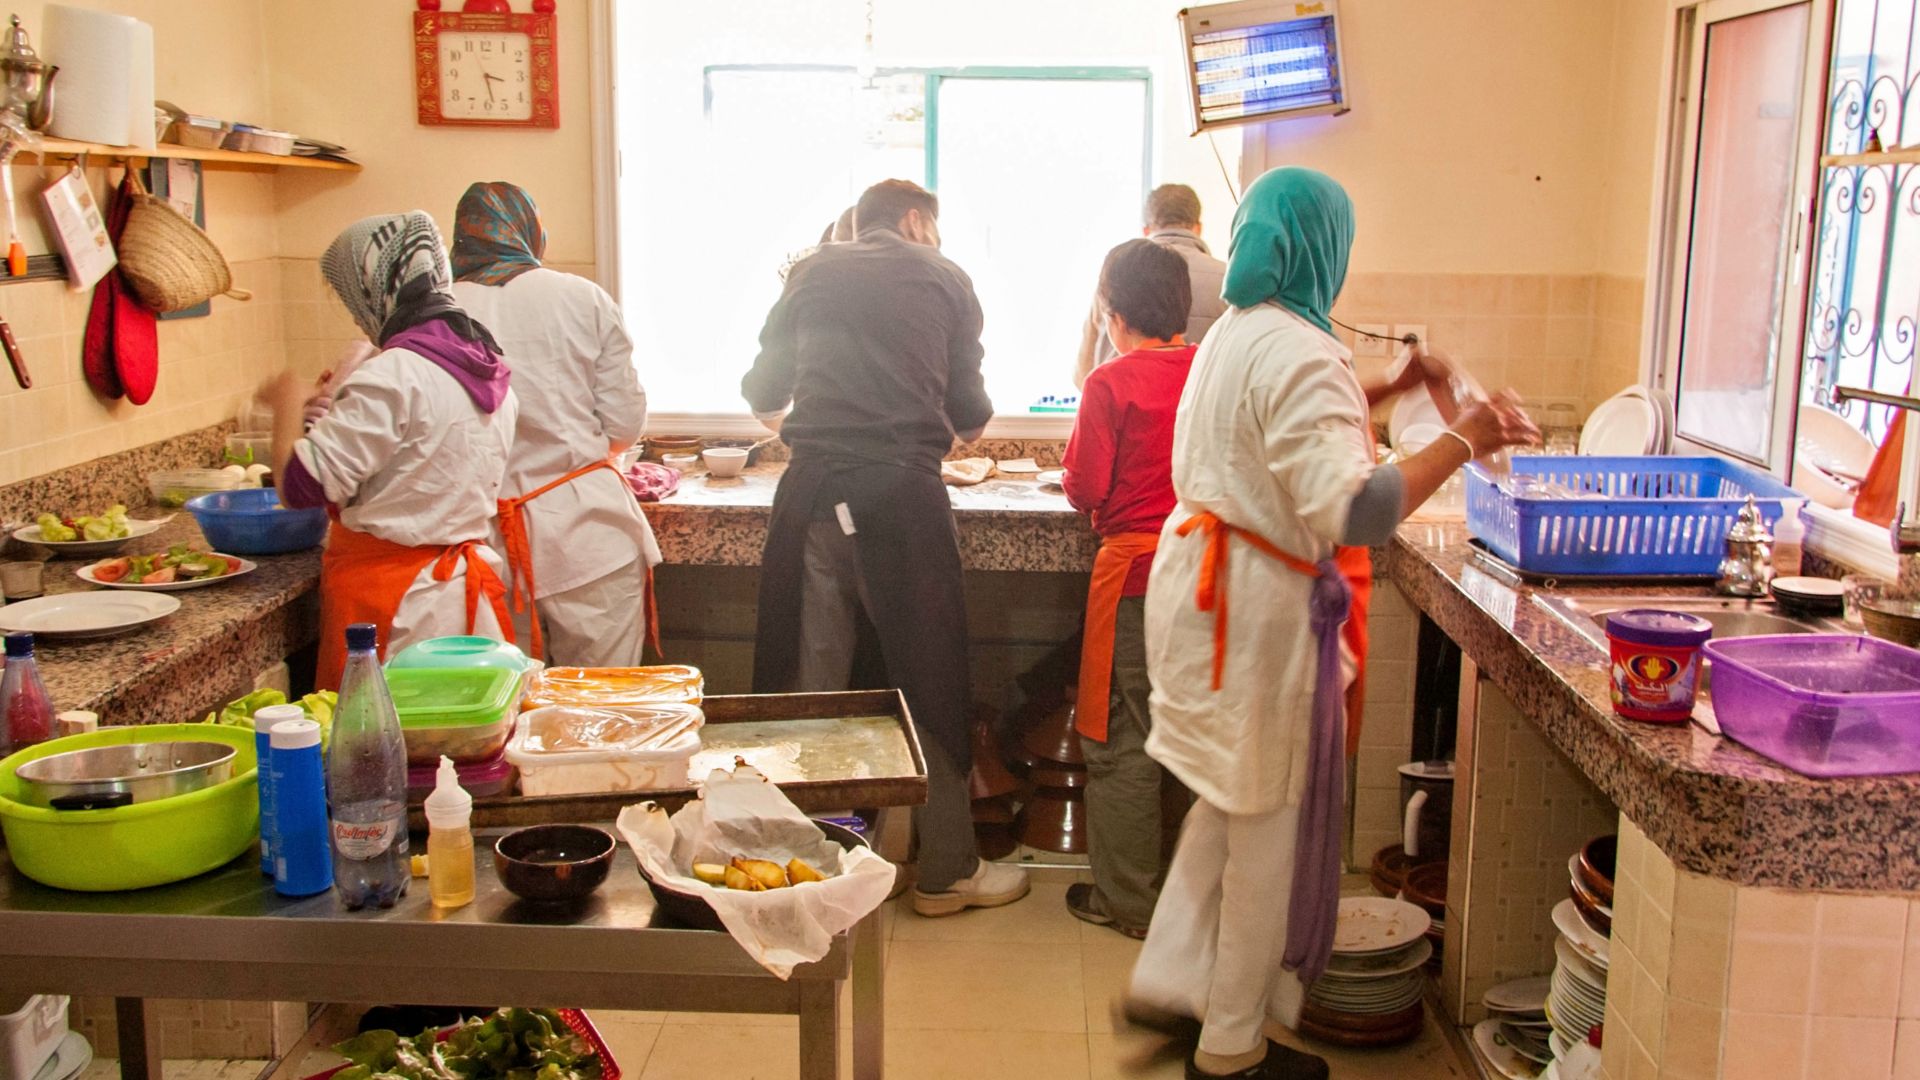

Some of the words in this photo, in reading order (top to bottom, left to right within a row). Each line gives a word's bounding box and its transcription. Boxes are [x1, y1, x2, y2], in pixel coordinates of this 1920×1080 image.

[465, 40, 474, 52] 11
[480, 40, 491, 52] 12
[450, 50, 461, 62] 10
[514, 50, 522, 63] 2
[450, 68, 458, 80] 9
[516, 70, 524, 82] 3
[451, 89, 460, 101] 8
[516, 91, 523, 103] 4
[468, 97, 476, 110] 7
[484, 100, 493, 111] 6
[501, 98, 509, 111] 5
